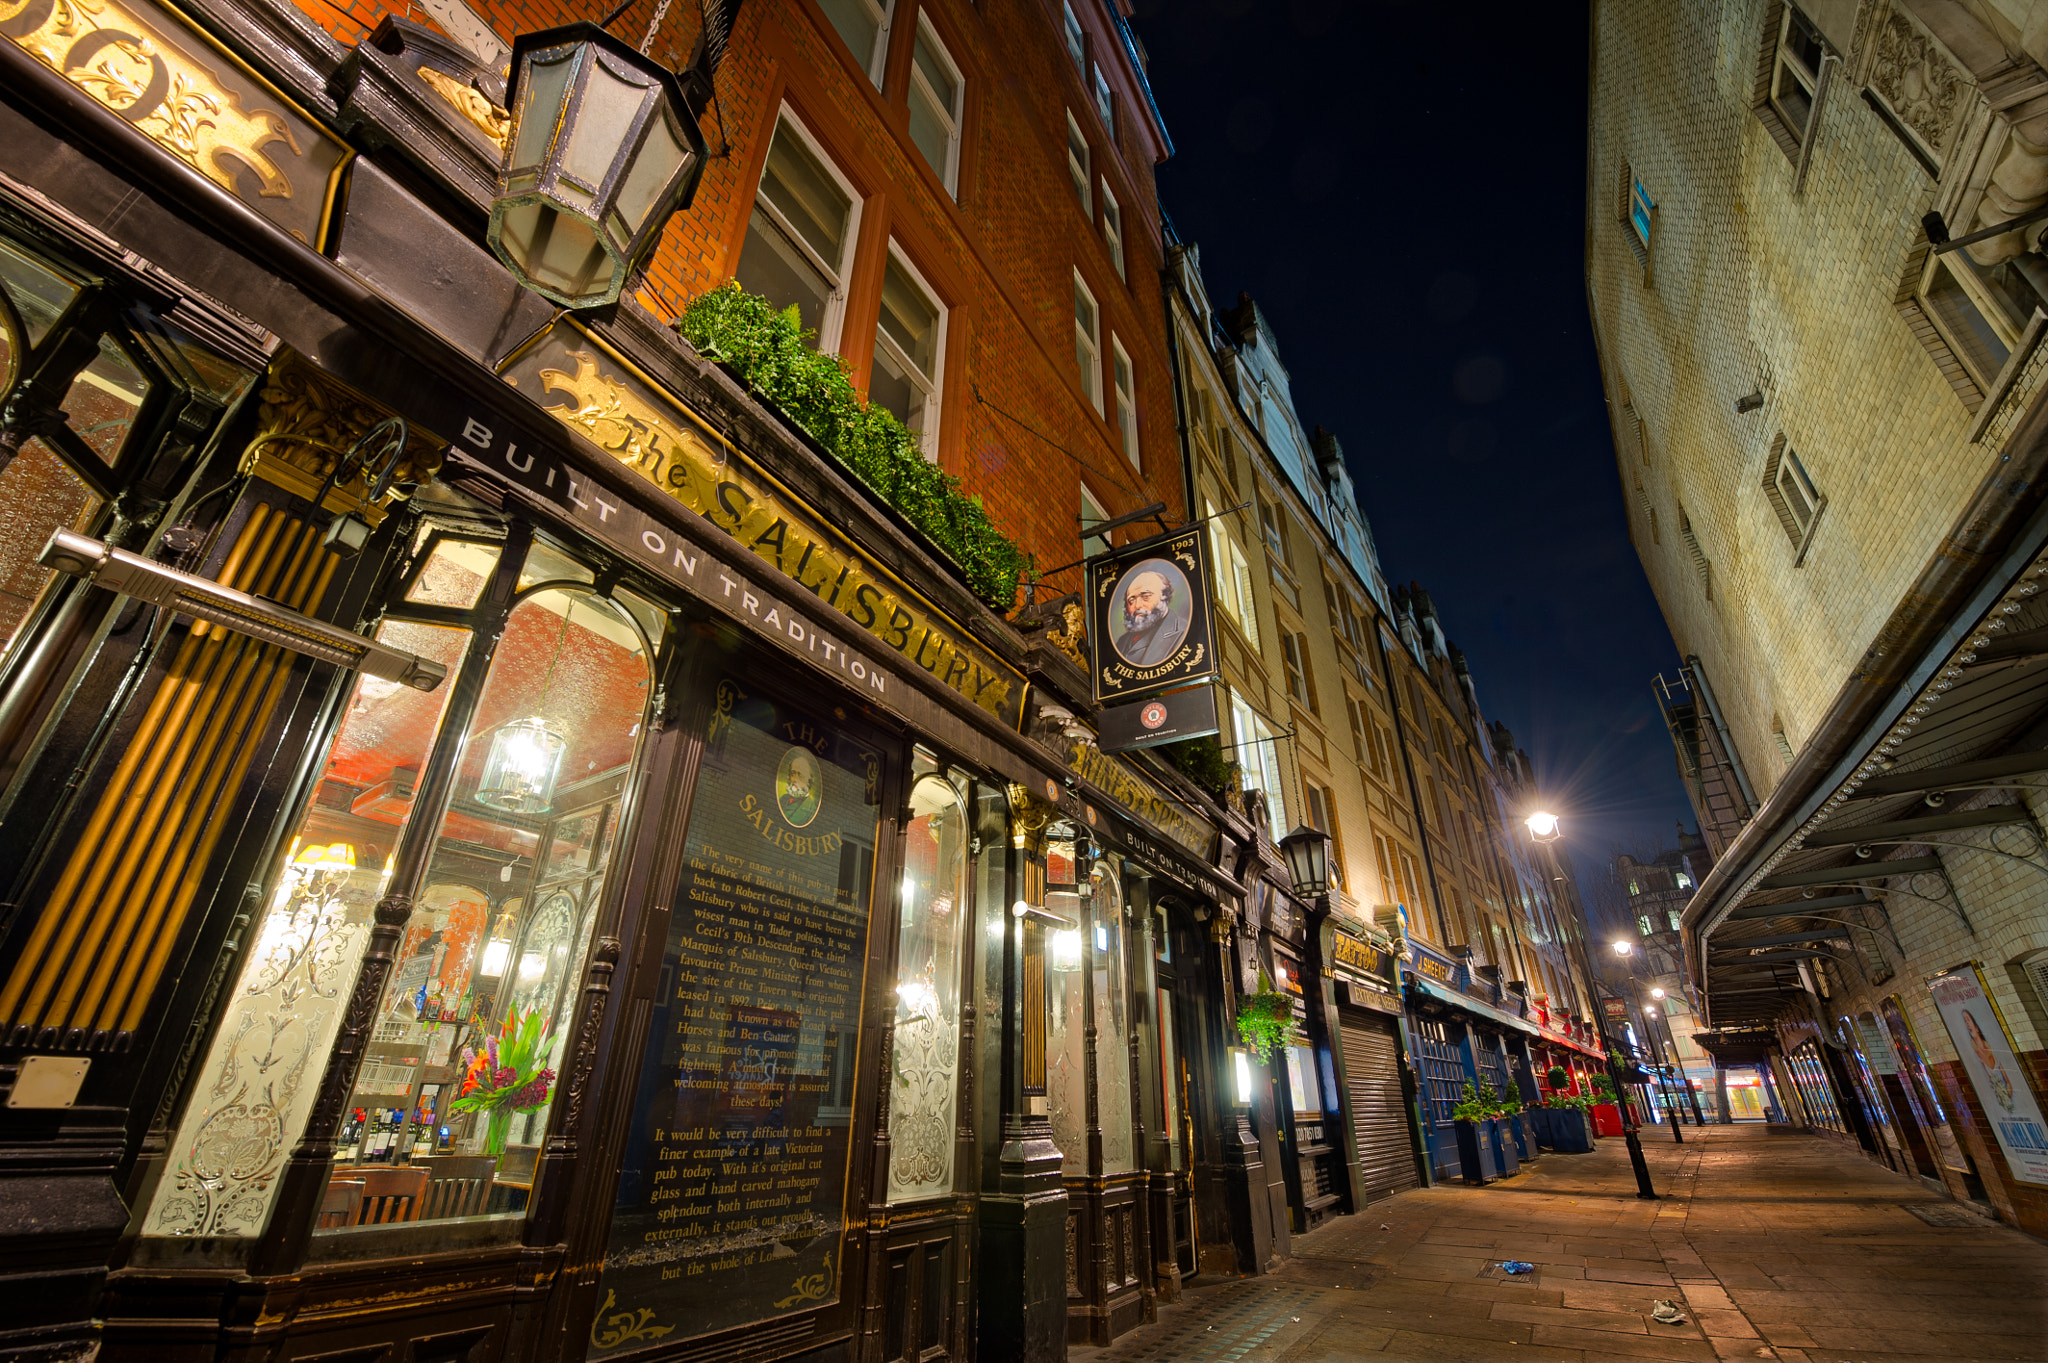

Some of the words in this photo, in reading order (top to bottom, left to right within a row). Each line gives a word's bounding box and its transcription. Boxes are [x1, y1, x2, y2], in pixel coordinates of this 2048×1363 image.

[461, 417, 617, 523] BUILT
[642, 530, 698, 576] ON
[720, 574, 887, 694] TRADITION
[604, 413, 690, 489] The
[702, 480, 998, 704] SALISBURY
[1171, 538, 1194, 552] 1903
[1113, 662, 1134, 680] THE
[1135, 644, 1192, 681] SALISBURY
[783, 721, 829, 755] THE
[739, 795, 844, 856] SALISBURY
[701, 845, 720, 859] The
[724, 854, 745, 869] very
[749, 862, 772, 874] name
[775, 868, 785, 878] of
[1127, 833, 1156, 859] BUILT
[1159, 854, 1173, 869] ON
[690, 858, 707, 870] the
[710, 862, 738, 879] fabric
[741, 872, 752, 883] of
[755, 875, 784, 891] British
[693, 873, 716, 888] back
[720, 882, 731, 892] to
[734, 884, 766, 902] Robert
[769, 894, 793, 911] Cecil,
[796, 902, 809, 913] the
[812, 905, 828, 918] first
[688, 888, 735, 912] Salisbury
[740, 903, 759, 915] who
[762, 906, 770, 917] is
[773, 911, 790, 922] said
[793, 915, 802, 925] to
[805, 917, 822, 930] have
[825, 922, 842, 935] been
[845, 928, 856, 938] the
[694, 907, 725, 922] wisest
[728, 917, 749, 927] man
[753, 919, 763, 930] in
[768, 922, 792, 937] Tudor
[795, 931, 825, 945] politics.
[828, 936, 834, 947] It
[837, 941, 850, 950] was
[680, 936, 722, 954] Marquis
[727, 946, 737, 957] of
[789, 957, 814, 971] Queen
[819, 963, 851, 978] Victoria's
[695, 923, 729, 940] Cecil's
[734, 931, 753, 944] 19th
[811, 947, 823, 958] the
[826, 950, 845, 962] third
[1336, 933, 1378, 972] TATTOO
[680, 953, 725, 970] favourite
[729, 961, 757, 976] Prime
[762, 967, 801, 985] Minister,
[805, 974, 823, 986] from
[828, 979, 849, 991] whom
[680, 970, 697, 982] the
[702, 974, 719, 986] site
[724, 977, 733, 988] of
[739, 979, 752, 990] the
[758, 981, 785, 995] Tavern
[791, 989, 805, 998] was
[809, 991, 845, 1007] originally
[677, 986, 709, 1001] leased
[713, 992, 724, 1003] in
[729, 993, 751, 1006] 1892.
[815, 1005, 827, 1016] the
[831, 1008, 844, 1020] pub
[683, 1005, 704, 1017] had
[709, 1008, 733, 1021] been
[737, 1011, 769, 1025] known
[772, 1018, 782, 1026] as
[785, 1017, 799, 1028] the
[802, 1019, 826, 1031] Coach
[830, 1022, 836, 1032] &
[676, 1022, 712, 1036] Horses
[717, 1027, 736, 1038] and
[739, 1028, 759, 1040] Ben
[823, 1037, 838, 1046] and
[679, 1057, 723, 1074] fighting.
[729, 1060, 736, 1071] A
[814, 1066, 829, 1076] and
[681, 1042, 701, 1051] was
[706, 1041, 742, 1055] famous
[811, 1051, 831, 1063] prize
[674, 1076, 728, 1092] welcoming
[732, 1079, 785, 1093] atmosphere
[788, 1081, 796, 1090] is
[799, 1081, 830, 1091] assured
[730, 1096, 756, 1107] these
[758, 1096, 784, 1109] days!
[654, 1129, 665, 1141] It
[670, 1128, 703, 1141] would
[708, 1128, 721, 1140] be
[726, 1130, 747, 1142] very
[752, 1126, 789, 1138] difficult
[793, 1128, 802, 1137] to
[805, 1126, 822, 1137] find
[825, 1128, 831, 1136] a
[659, 1147, 688, 1160] finer
[693, 1145, 735, 1161] example
[738, 1144, 748, 1156] of
[753, 1147, 759, 1156] a
[763, 1143, 780, 1155] late
[785, 1142, 822, 1154] Victorian
[654, 1166, 677, 1183] pub
[682, 1165, 715, 1180] today.
[722, 1162, 747, 1175] With
[751, 1161, 766, 1173] it's
[770, 1158, 805, 1175] original
[808, 1159, 822, 1169] cut
[651, 1186, 679, 1203] glass
[686, 1183, 705, 1196] and
[712, 1180, 736, 1194] hand
[742, 1178, 772, 1192] carved
[777, 1176, 819, 1190] mahogany
[717, 1198, 740, 1212] both
[745, 1193, 791, 1209] internally
[795, 1191, 812, 1204] and
[644, 1222, 707, 1240] externally,
[712, 1220, 720, 1232] it
[725, 1215, 757, 1230] stands
[761, 1214, 777, 1226] out
[661, 1266, 681, 1279] but
[687, 1262, 705, 1275] the
[710, 1256, 739, 1271] whole
[744, 1253, 754, 1265] of
